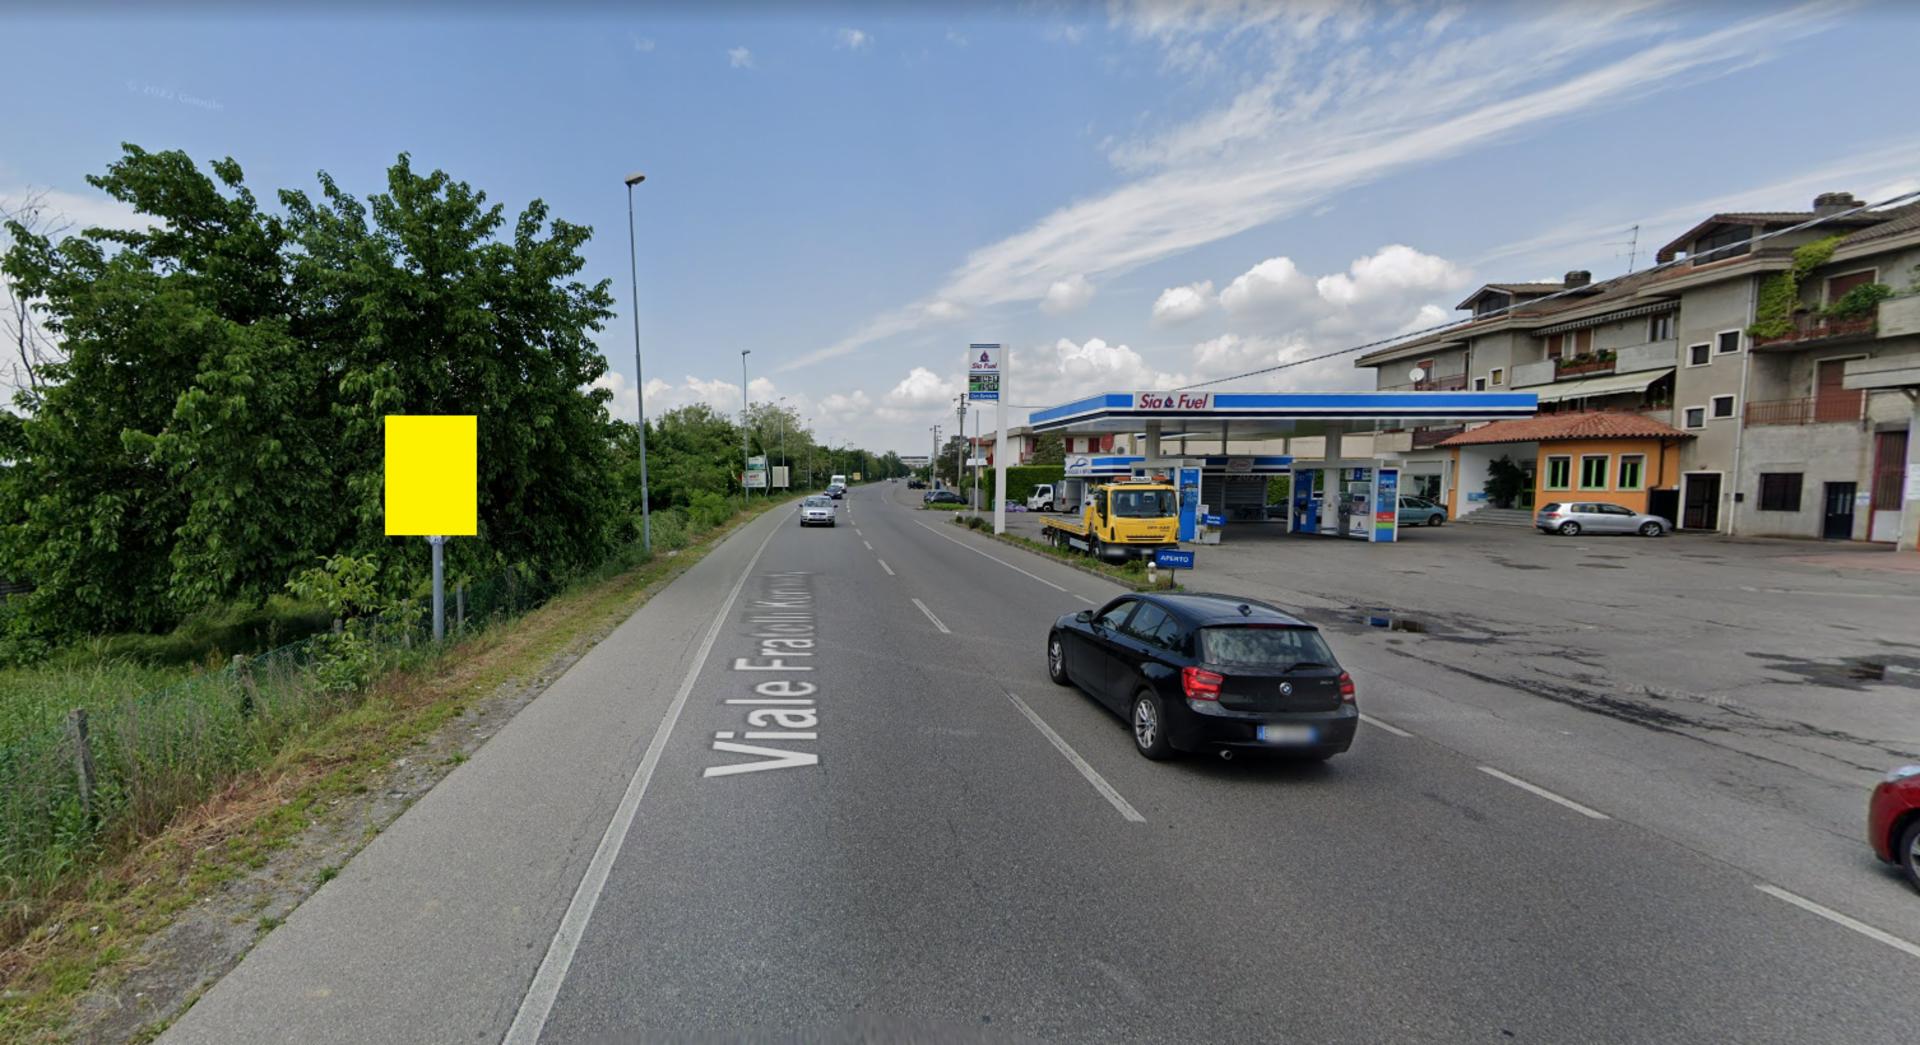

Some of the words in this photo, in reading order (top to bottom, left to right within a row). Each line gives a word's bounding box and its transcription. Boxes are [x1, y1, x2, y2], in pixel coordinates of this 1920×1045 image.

[1139, 393, 1162, 409] Sia
[1178, 393, 1208, 409] Fuel
[1160, 555, 1189, 563] APERTO
